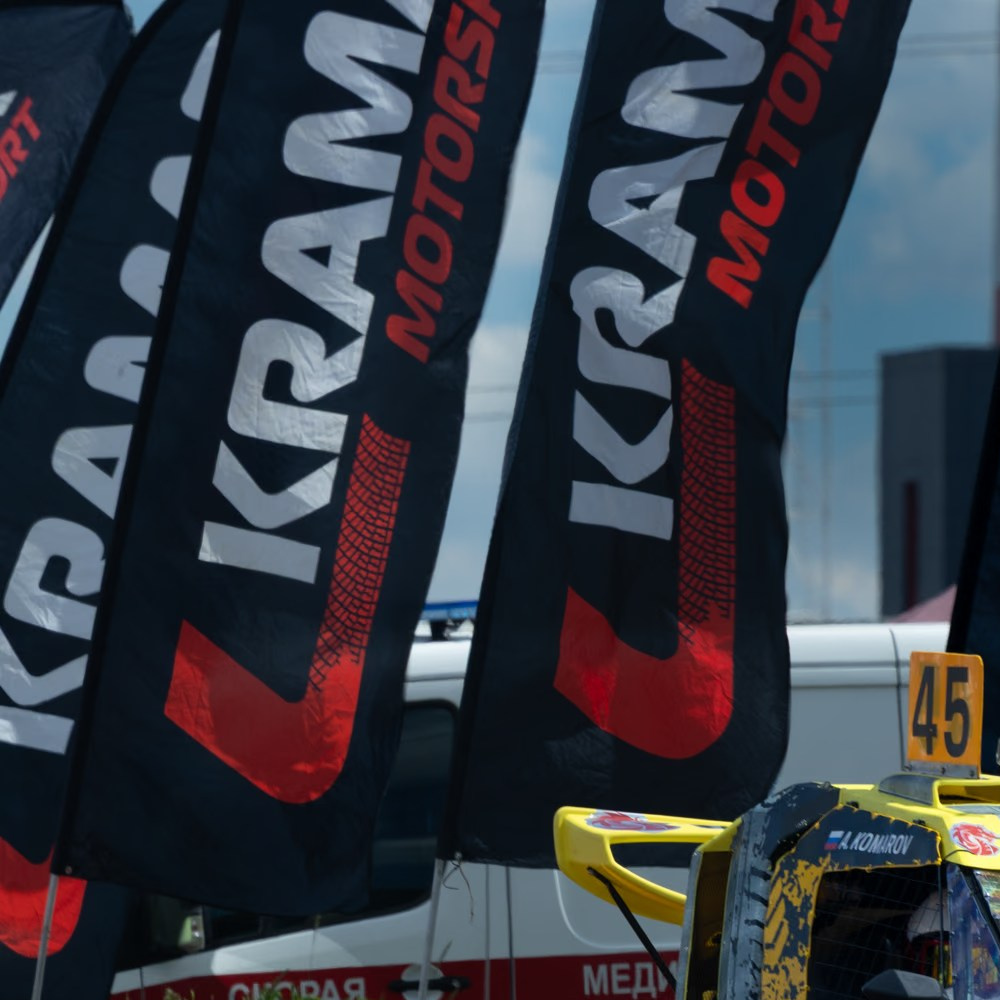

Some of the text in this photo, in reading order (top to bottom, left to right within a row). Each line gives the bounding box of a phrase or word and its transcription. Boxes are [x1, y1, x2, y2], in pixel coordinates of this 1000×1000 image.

[198, 0, 434, 583] KRAM
[706, 0, 850, 308] MOTOR
[912, 666, 970, 758] 45
